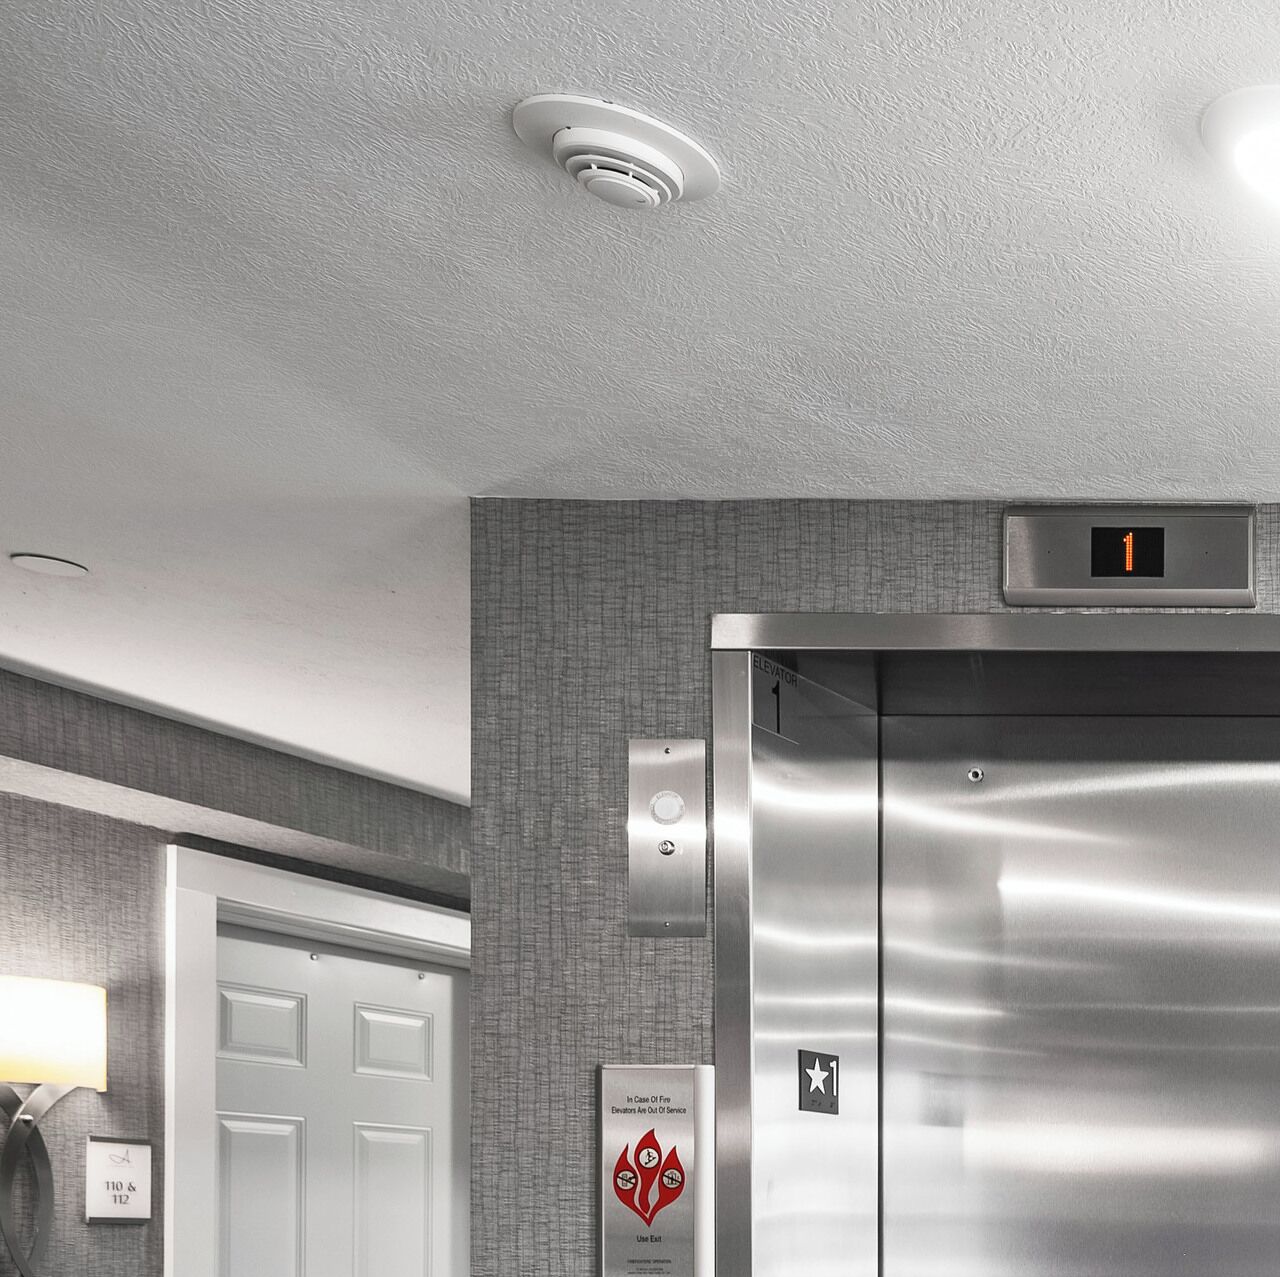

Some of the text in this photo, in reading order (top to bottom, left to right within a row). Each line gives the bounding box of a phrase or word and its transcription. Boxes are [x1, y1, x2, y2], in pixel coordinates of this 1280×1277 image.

[1124, 532, 1133, 571] 1
[753, 655, 798, 688] ELEVATOR
[772, 680, 780, 734] 1
[830, 1060, 837, 1096] 1
[611, 1106, 687, 1114] Elevators Are Out Of Service
[105, 1181, 137, 1192] 110 &
[112, 1194, 130, 1205] 112
[636, 1234, 662, 1243] Use Exit
